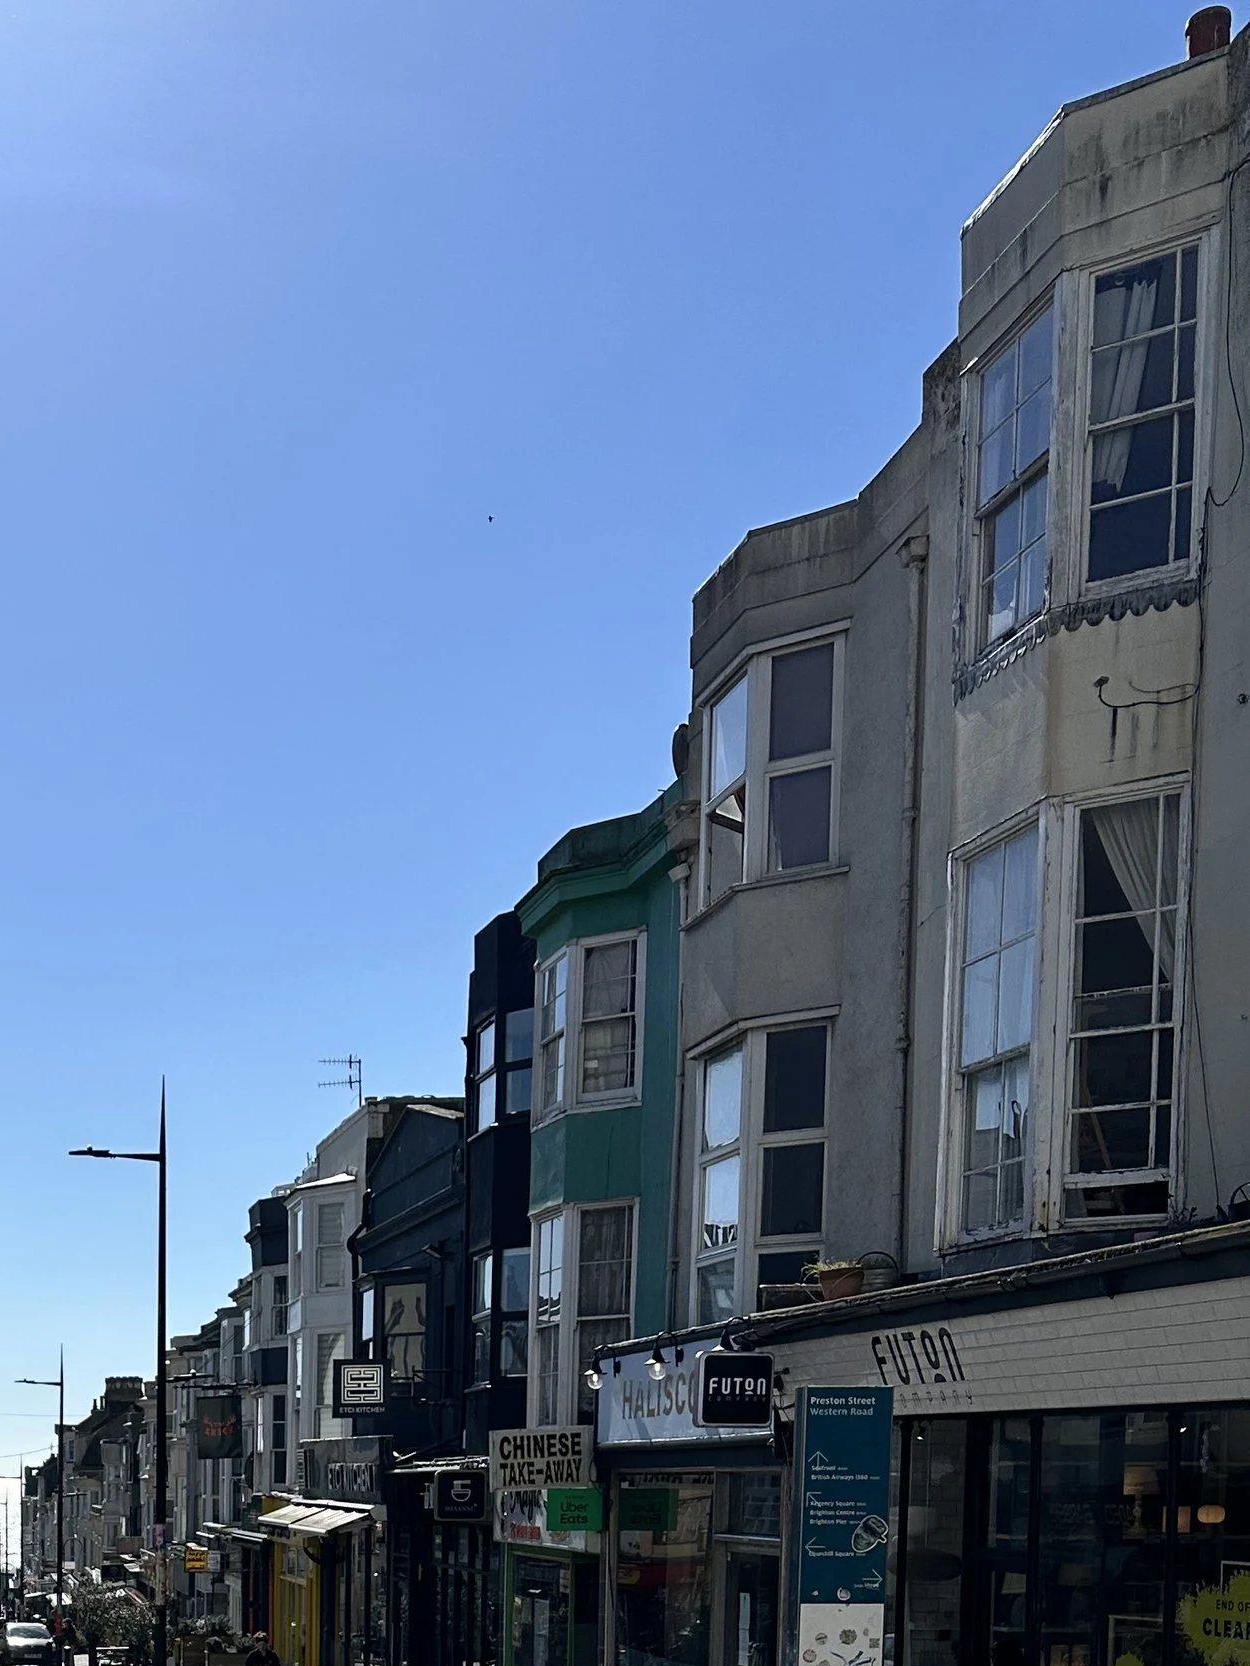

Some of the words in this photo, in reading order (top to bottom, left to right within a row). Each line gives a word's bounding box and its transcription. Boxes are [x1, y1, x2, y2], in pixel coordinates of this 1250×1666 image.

[871, 1327, 966, 1386] FUTON
[709, 1377, 767, 1396] FUTON
[810, 1396, 846, 1405] Preston
[848, 1396, 876, 1405] Street
[810, 1407, 848, 1416] Western
[850, 1407, 874, 1416] Road
[500, 1433, 582, 1460] CHINESE
[500, 1459, 582, 1487] TAKE-AWAY
[831, 1473, 855, 1482] Airways
[561, 1501, 590, 1513] Uber
[560, 1513, 589, 1525] Eats
[835, 1550, 855, 1558] Square
[1216, 1599, 1235, 1612] END
[1238, 1601, 1250, 1612] OF
